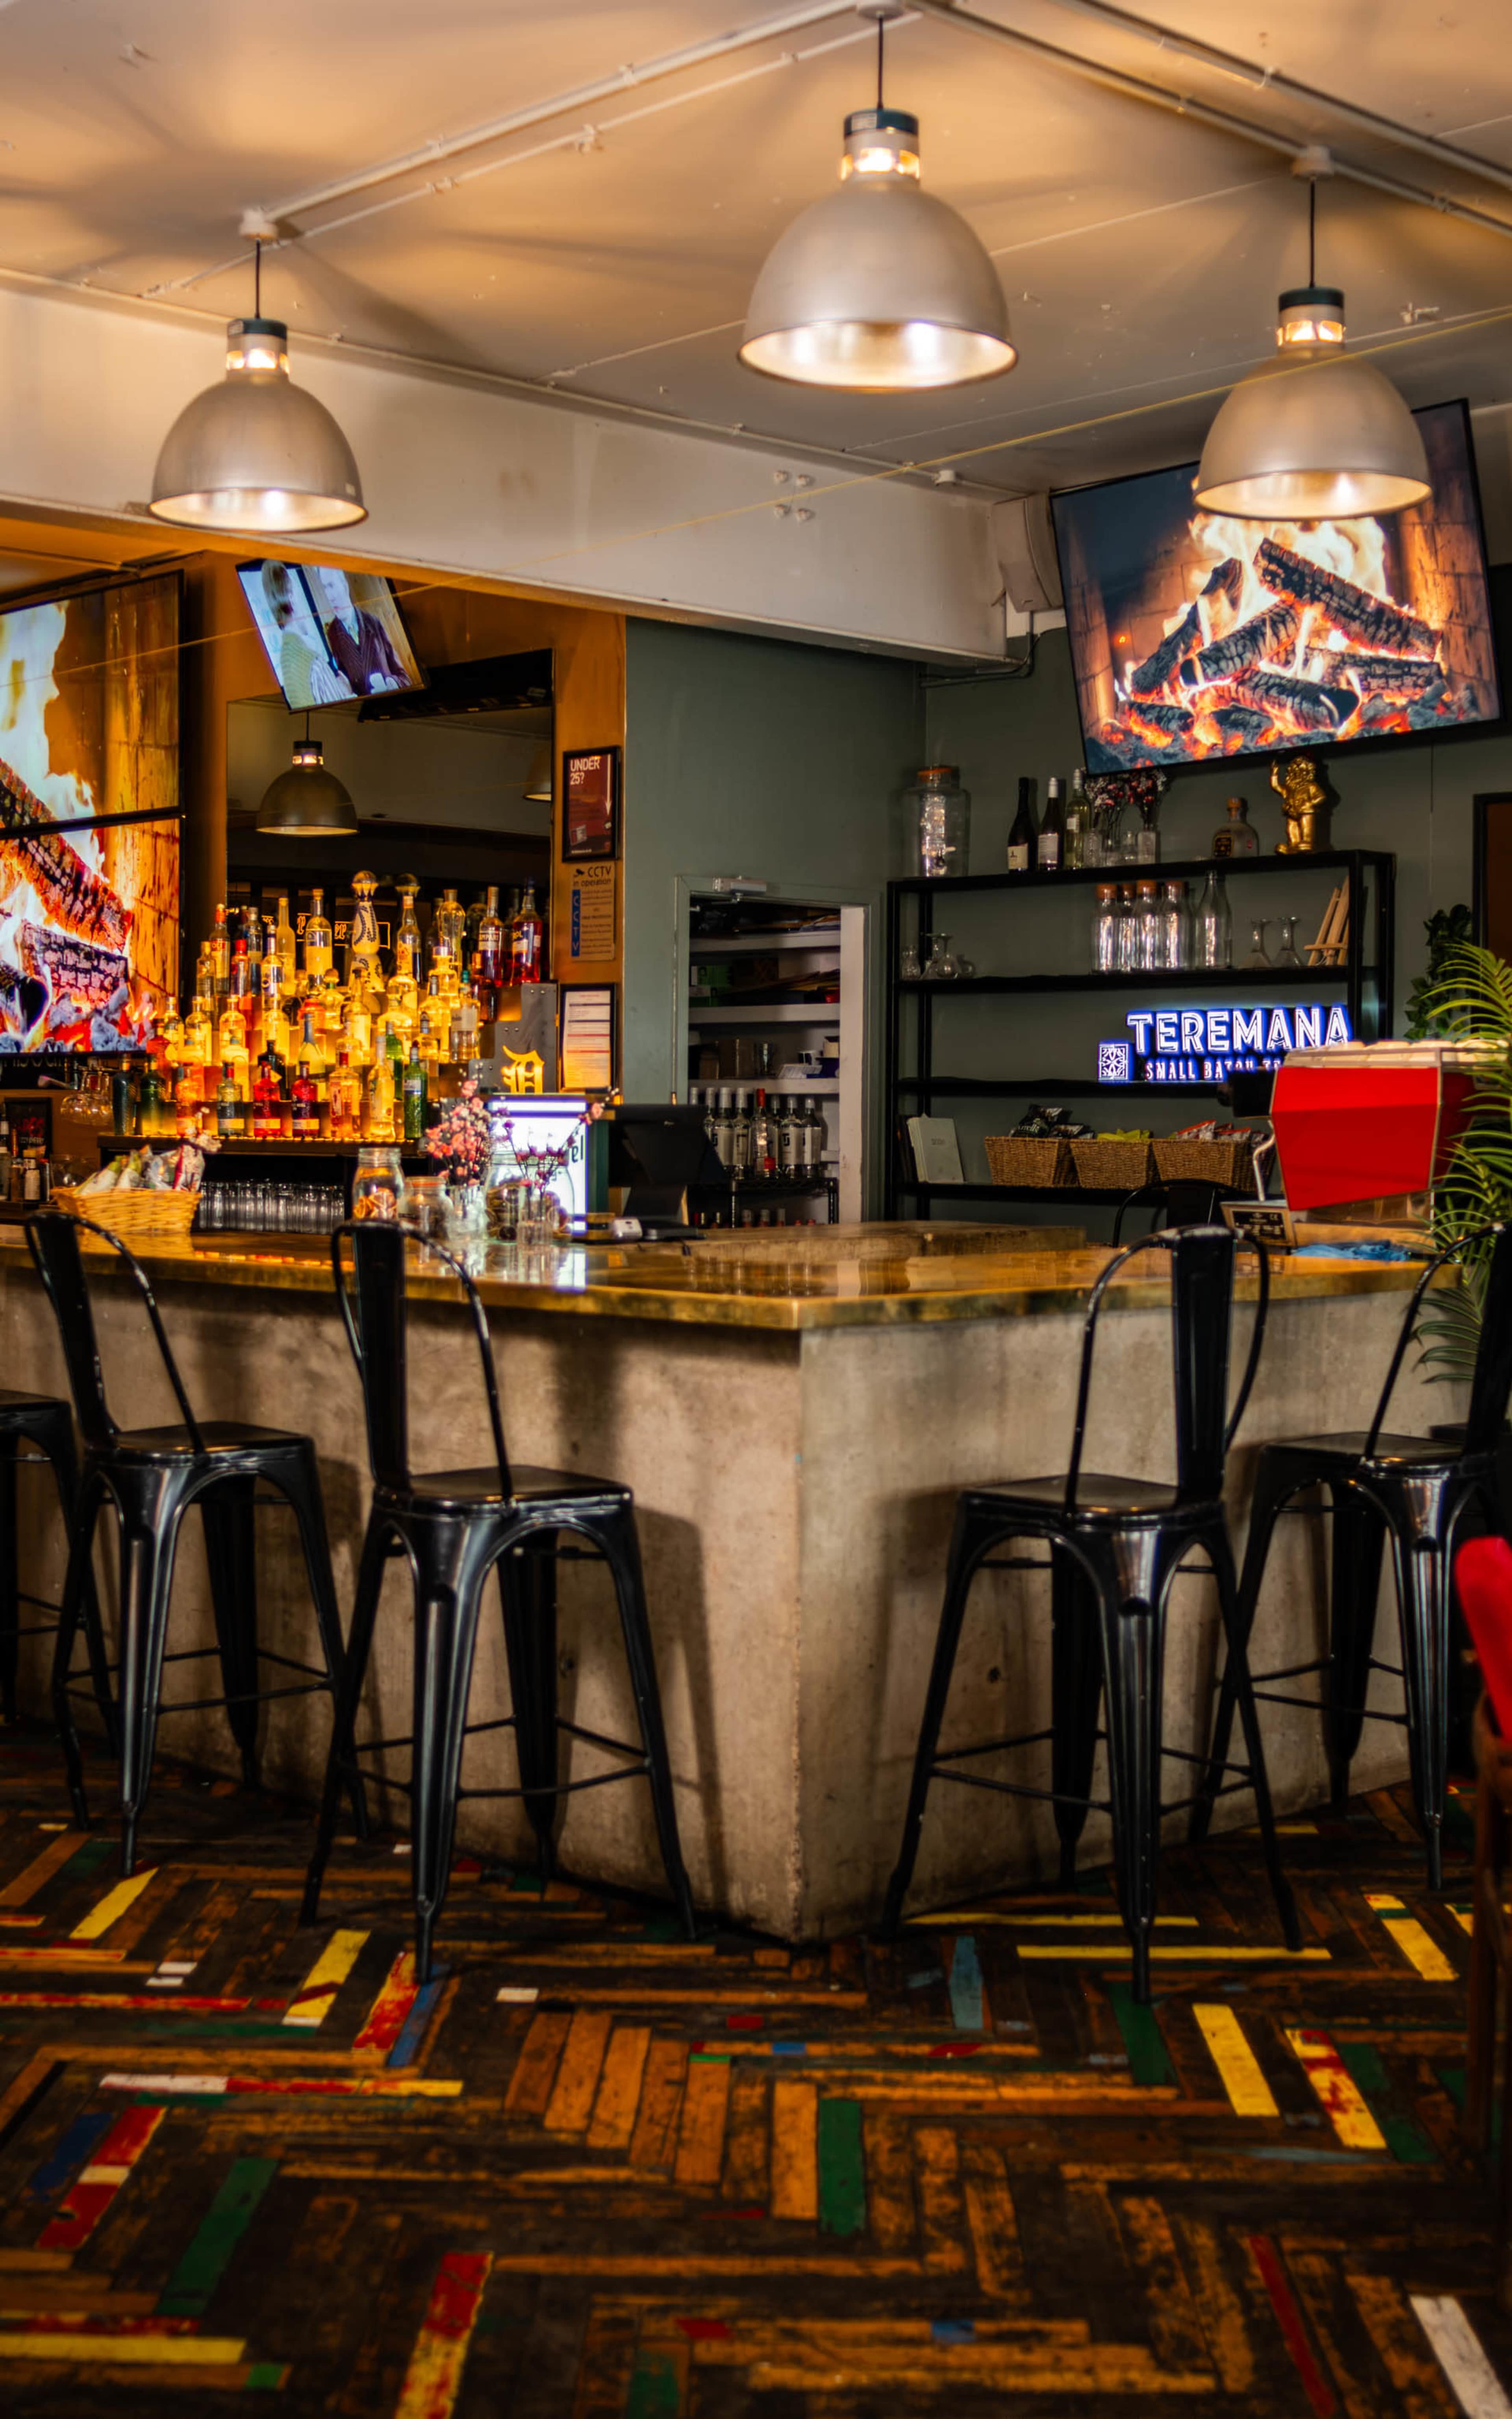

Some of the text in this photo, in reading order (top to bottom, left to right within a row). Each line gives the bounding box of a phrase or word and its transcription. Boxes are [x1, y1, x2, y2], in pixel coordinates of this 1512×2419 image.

[570, 759, 600, 771] UNDER
[570, 772, 585, 785] 25?
[587, 865, 611, 878] CCTV
[1127, 1007, 1348, 1054] TEREMANA
[1145, 1061, 1196, 1080] SMALL
